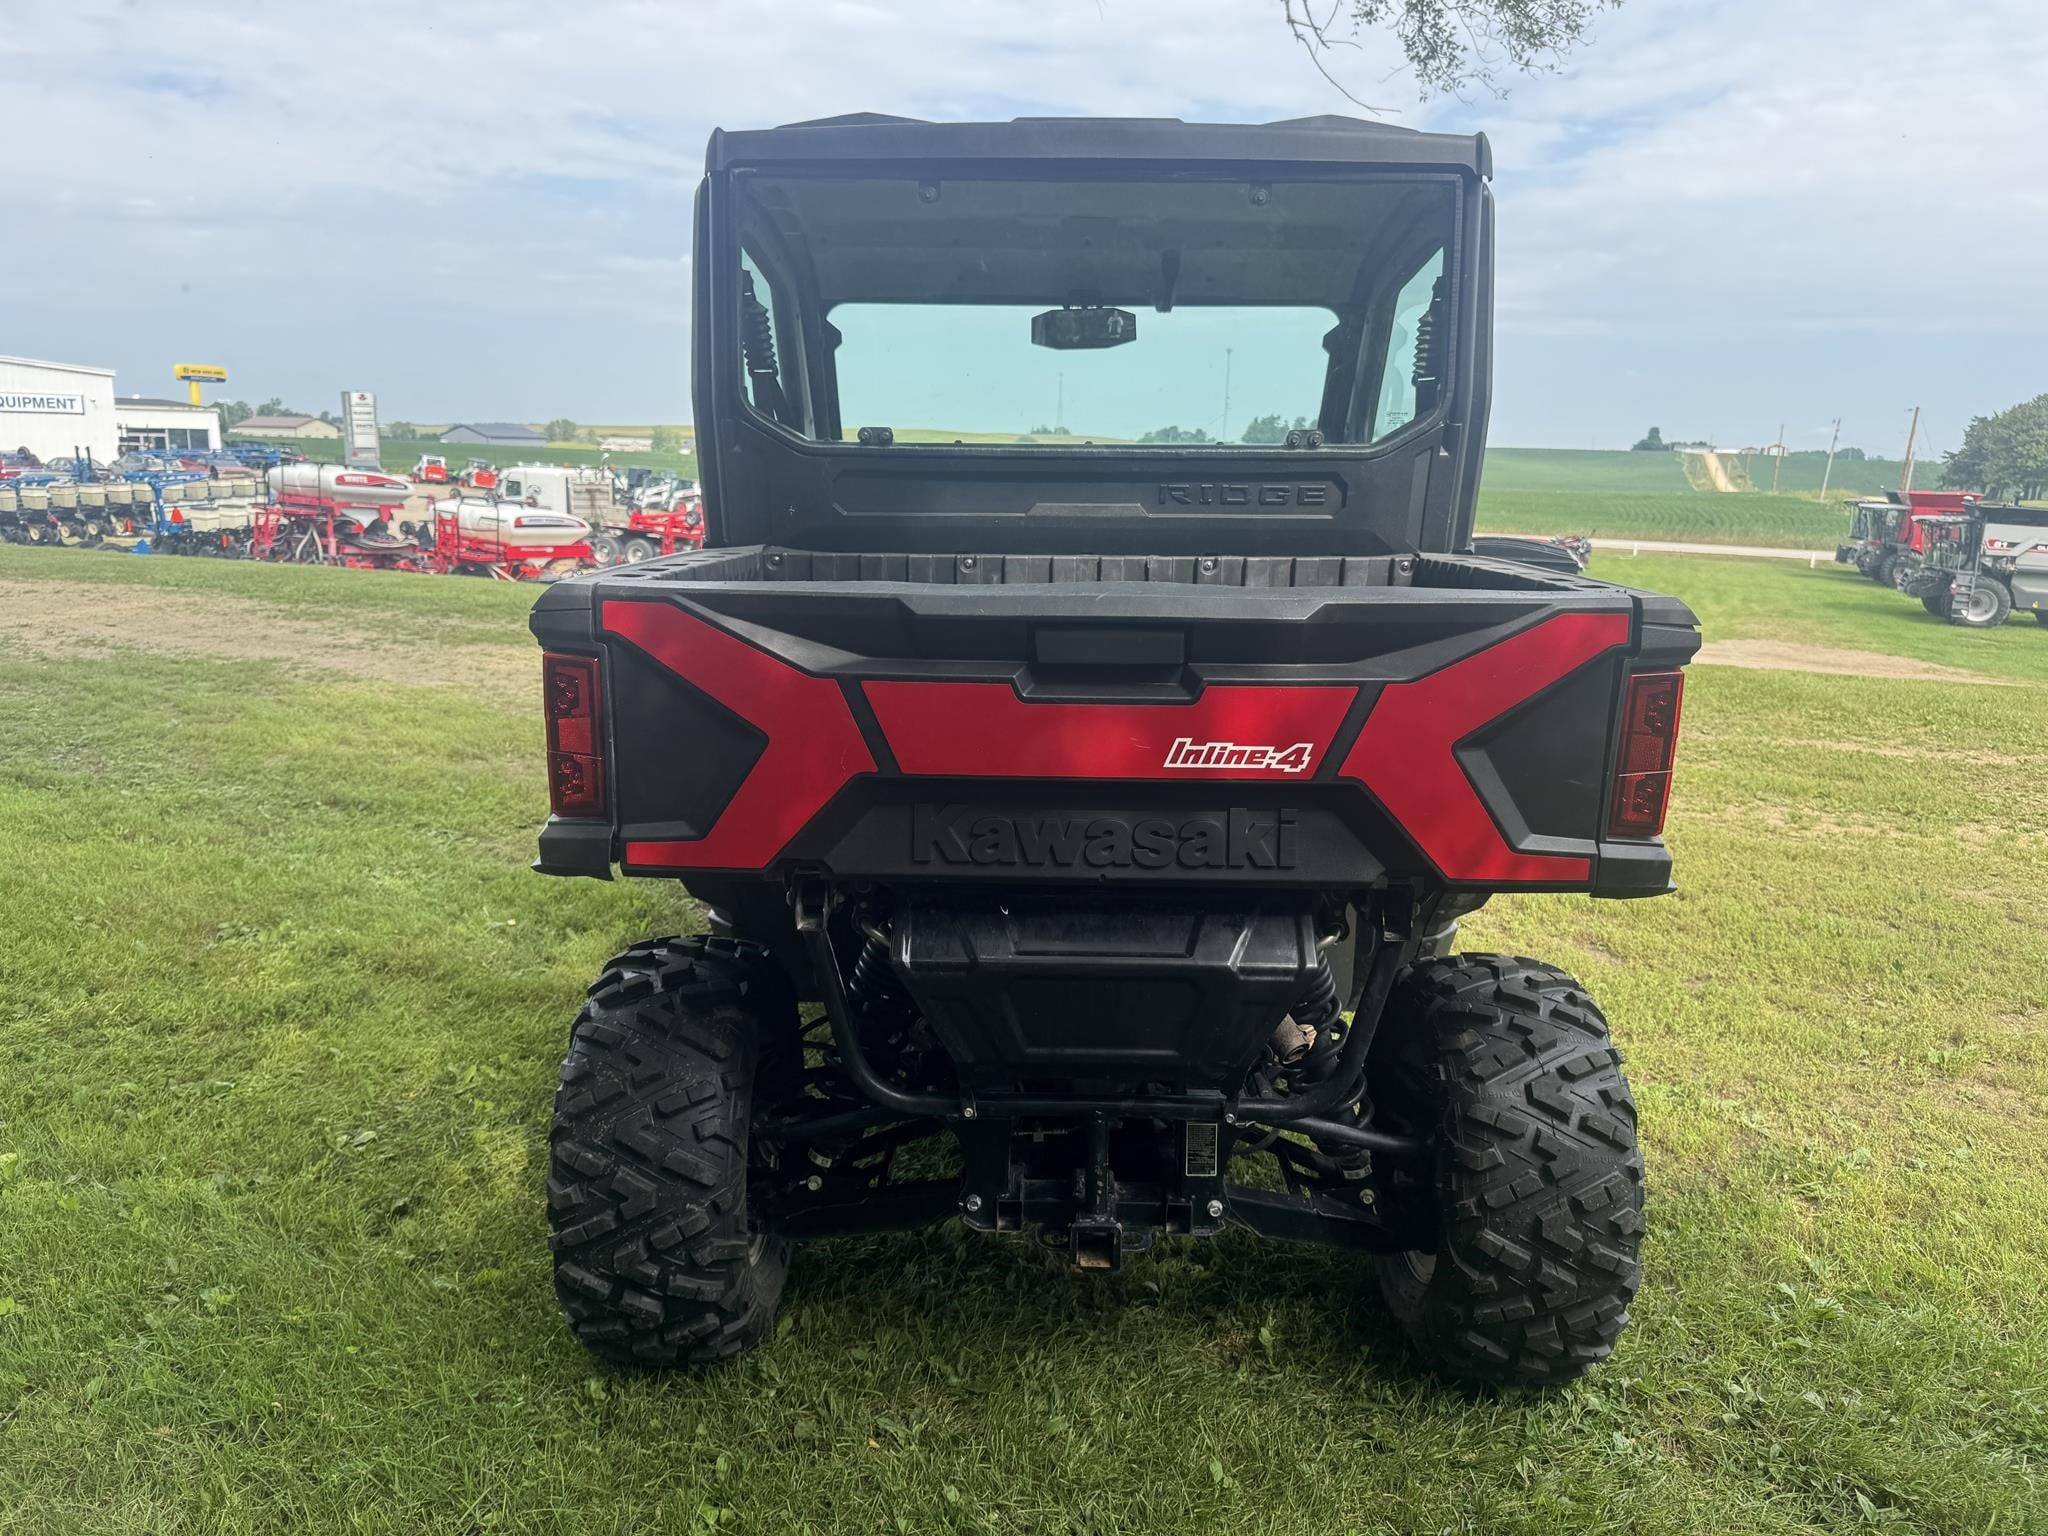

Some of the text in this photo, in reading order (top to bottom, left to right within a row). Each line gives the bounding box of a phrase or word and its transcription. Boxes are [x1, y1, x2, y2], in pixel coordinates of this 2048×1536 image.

[1158, 484, 1327, 505] RIDGE
[1163, 737, 1314, 773] Inline-4
[911, 801, 1298, 870] Kawasaki
